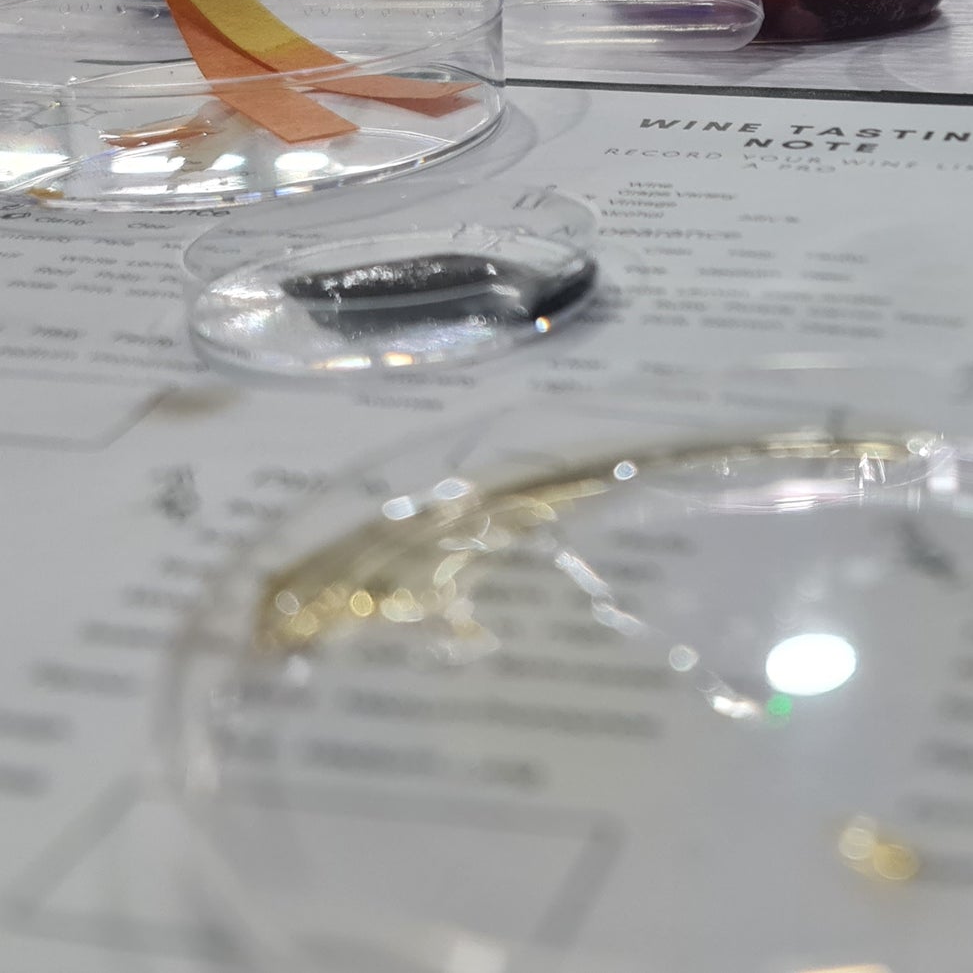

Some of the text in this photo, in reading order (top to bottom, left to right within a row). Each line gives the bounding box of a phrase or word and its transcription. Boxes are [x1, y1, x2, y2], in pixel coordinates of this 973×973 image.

[639, 118, 762, 133] WINE
[743, 138, 880, 154] NOTE
[604, 147, 723, 160] RECORD
[743, 153, 822, 164] YOUR
